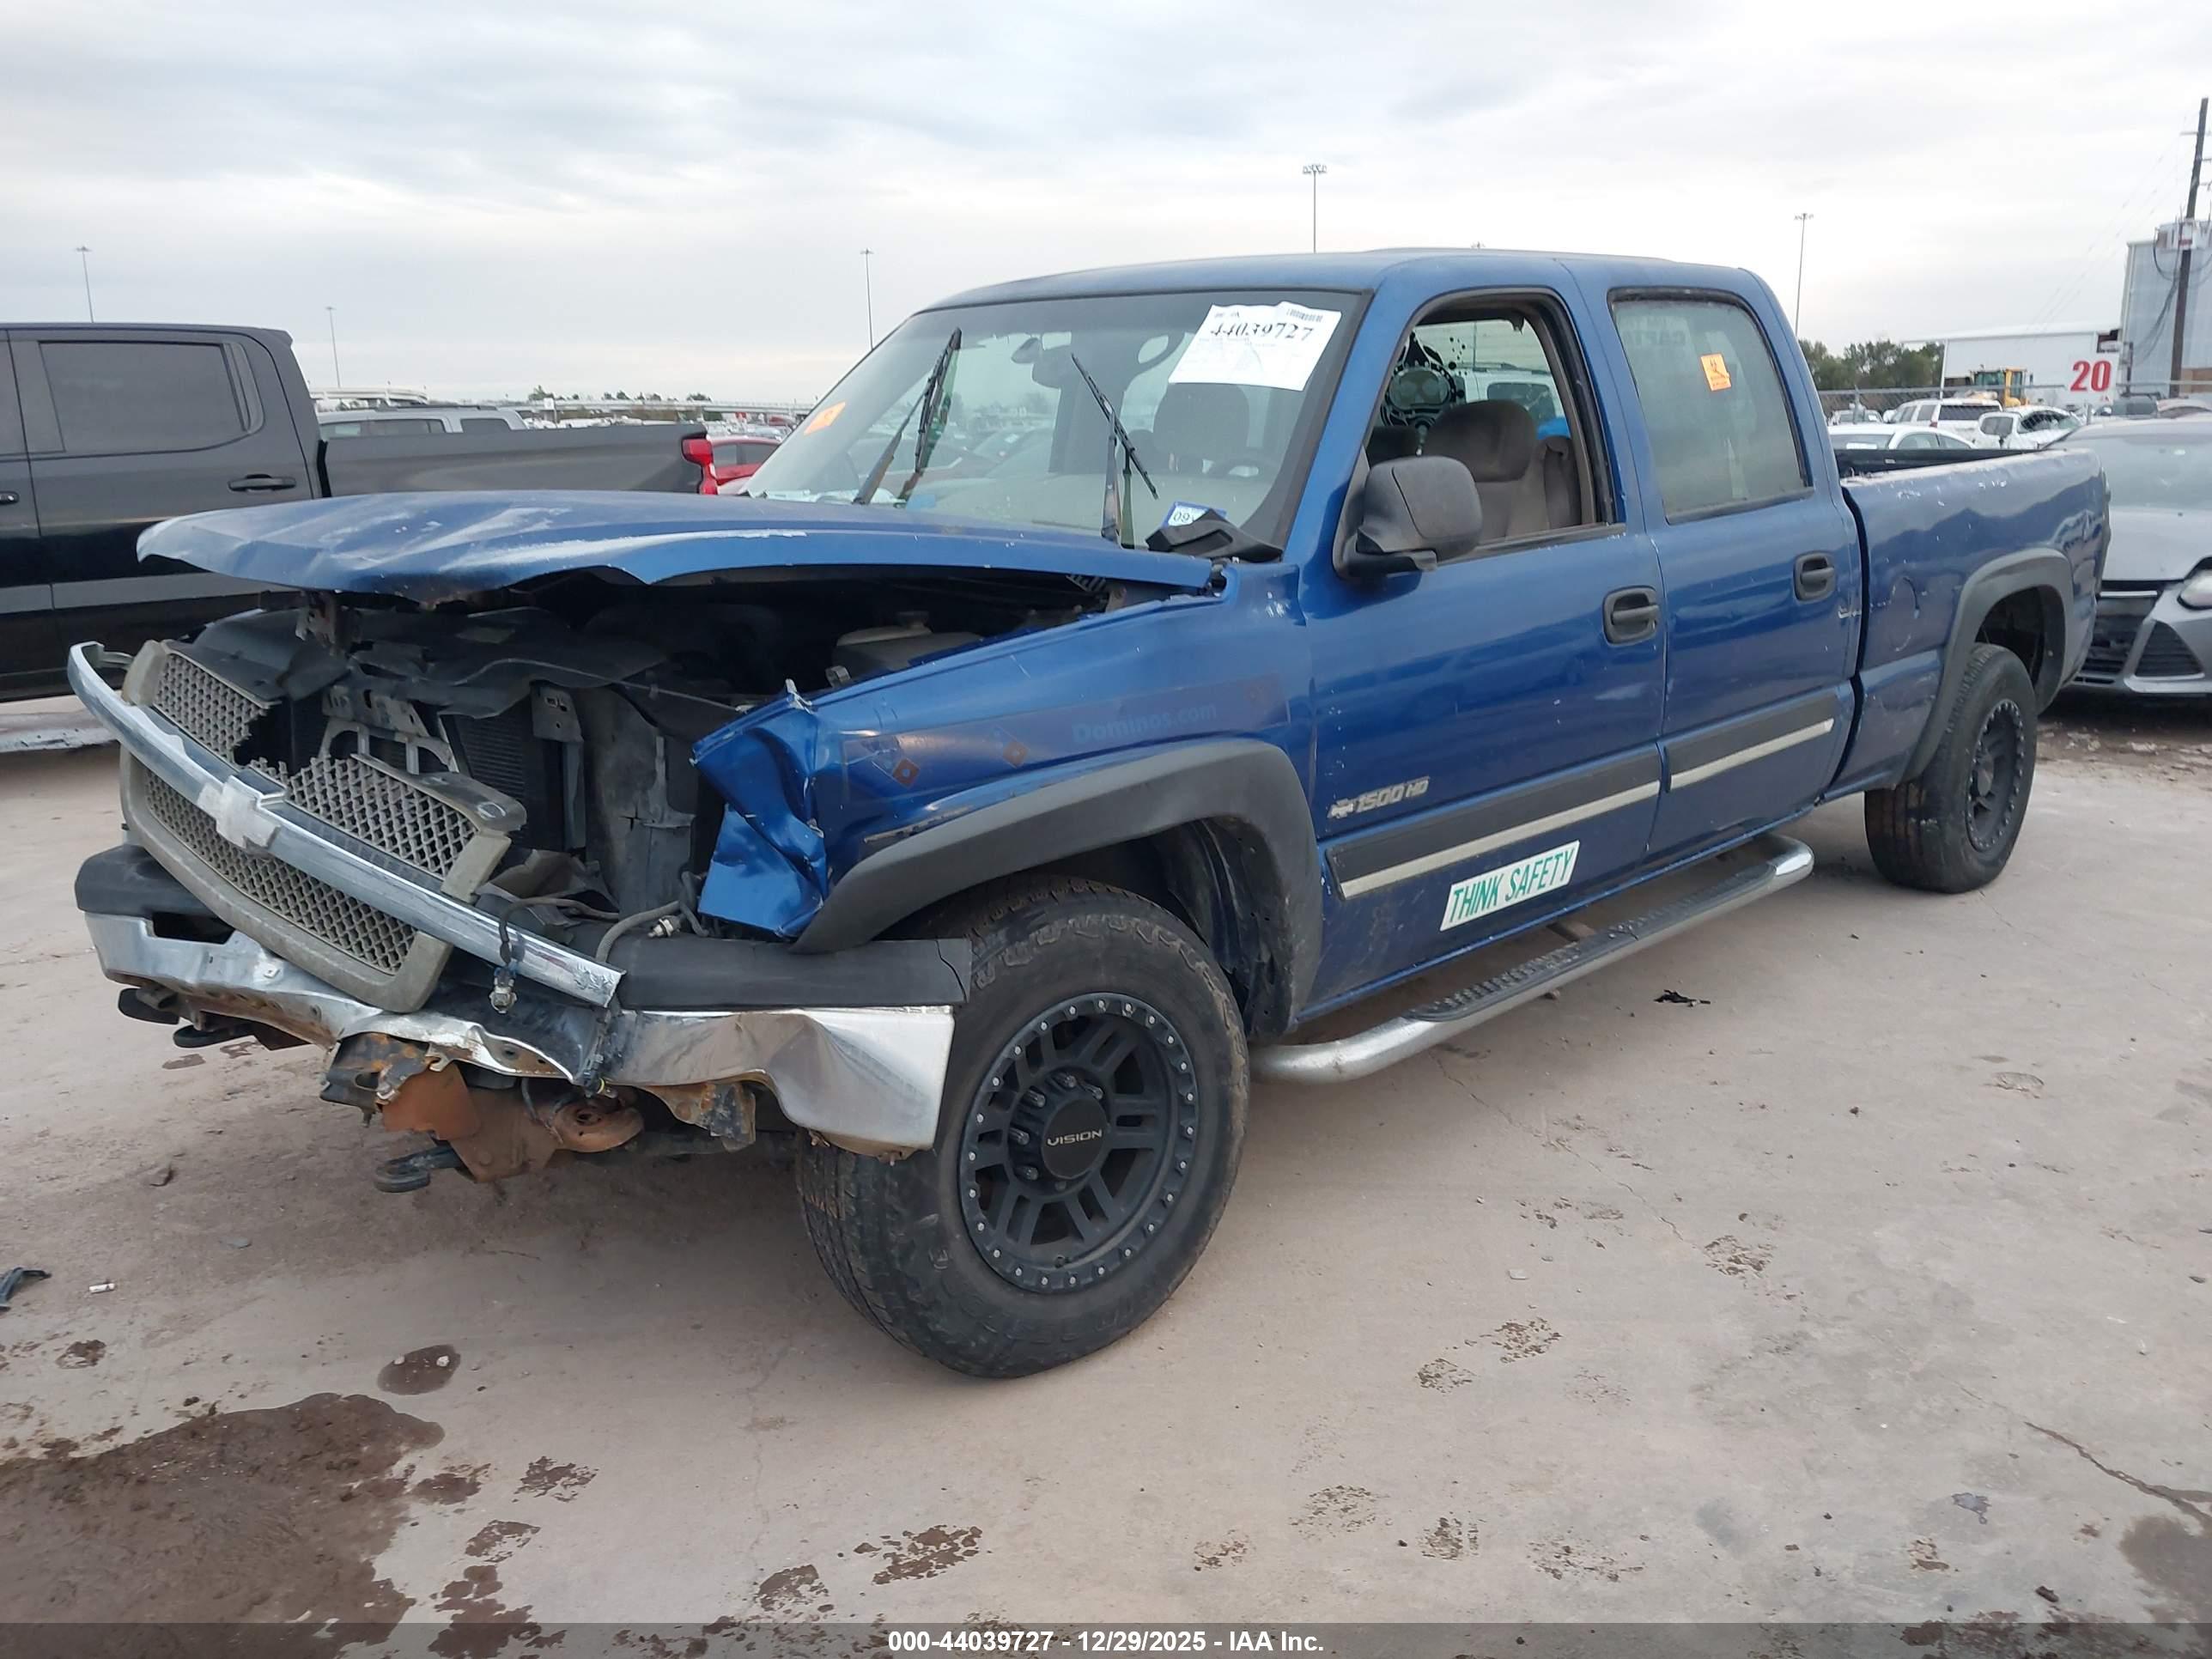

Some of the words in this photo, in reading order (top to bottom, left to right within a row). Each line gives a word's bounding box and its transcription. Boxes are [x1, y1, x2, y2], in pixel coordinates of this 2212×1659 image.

[2070, 360, 2112, 392] 20
[1072, 702, 1217, 744] Dominos.com
[1450, 873, 1504, 922] THINK
[1504, 848, 1576, 902] SAFETY
[1047, 1128, 1103, 1146] VISION
